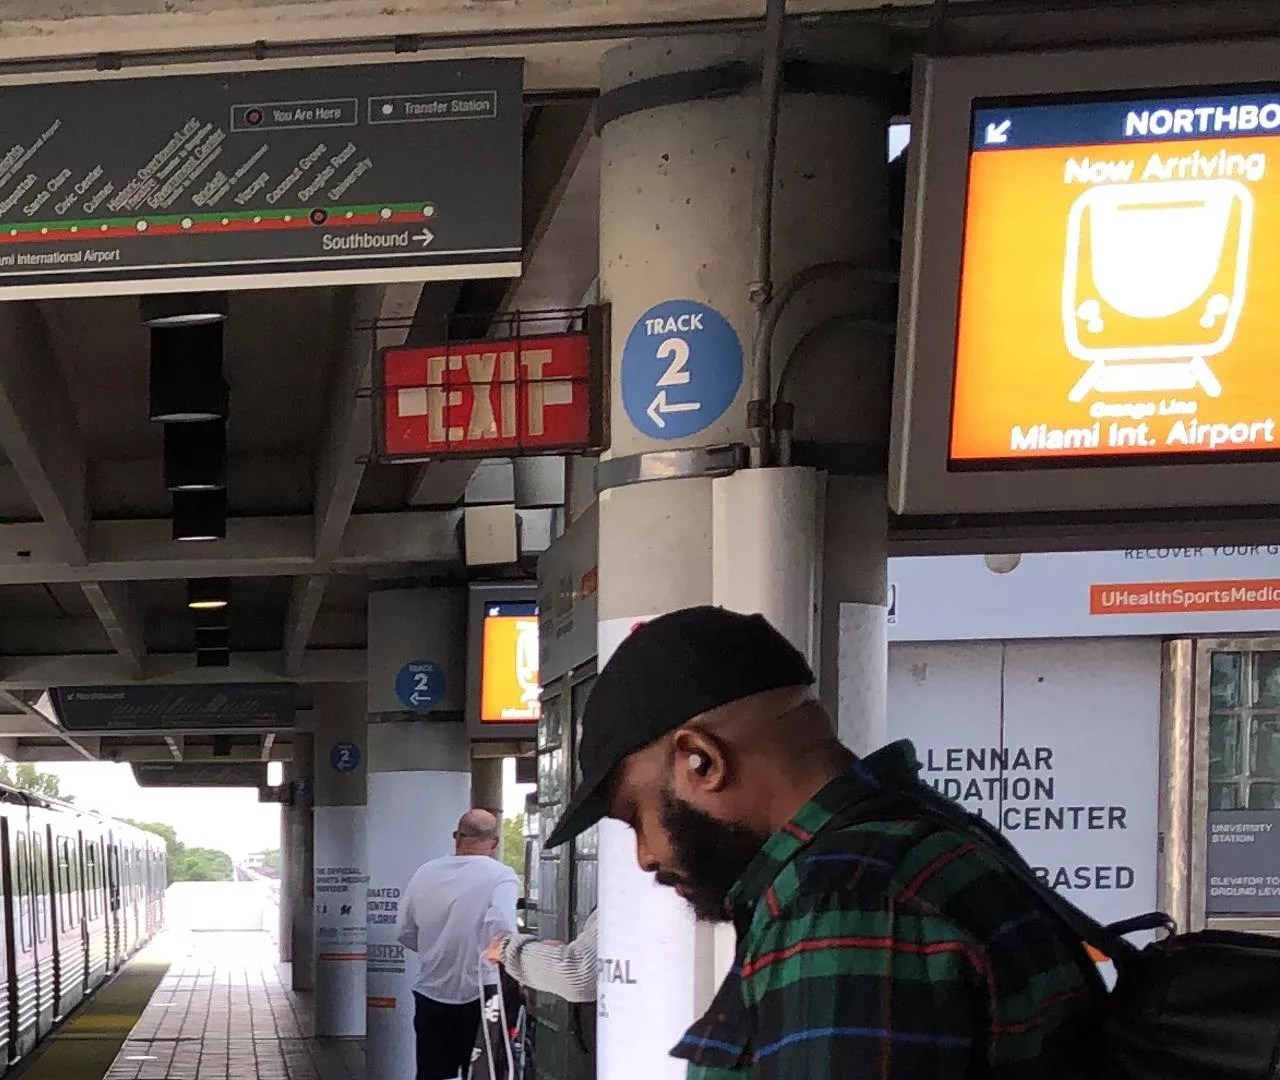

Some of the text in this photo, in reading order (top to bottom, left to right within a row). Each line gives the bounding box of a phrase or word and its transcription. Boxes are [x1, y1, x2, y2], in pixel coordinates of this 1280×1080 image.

[273, 107, 341, 122] You Are Here
[405, 99, 490, 114] Transfer Station
[1064, 150, 1265, 184] Now Arriving
[23, 167, 70, 215] Santa Clara
[55, 164, 103, 214] Civic Center
[83, 181, 114, 212] Culmer
[322, 231, 409, 251] Southbound
[17, 250, 82, 266] International
[83, 249, 121, 263] Airport
[644, 313, 704, 337] TRACK
[655, 338, 692, 387] 2
[426, 349, 552, 443] EXIT
[1010, 417, 1275, 450] Miami Int. Airport
[413, 673, 428, 691] 2
[340, 750, 351, 761] 2
[927, 747, 1053, 771] LENNAR
[1003, 807, 1127, 830] CENTER
[1212, 824, 1272, 832] UNIVERSITY
[1212, 834, 1254, 842] STATION
[1211, 877, 1263, 885] ELEVATOR
